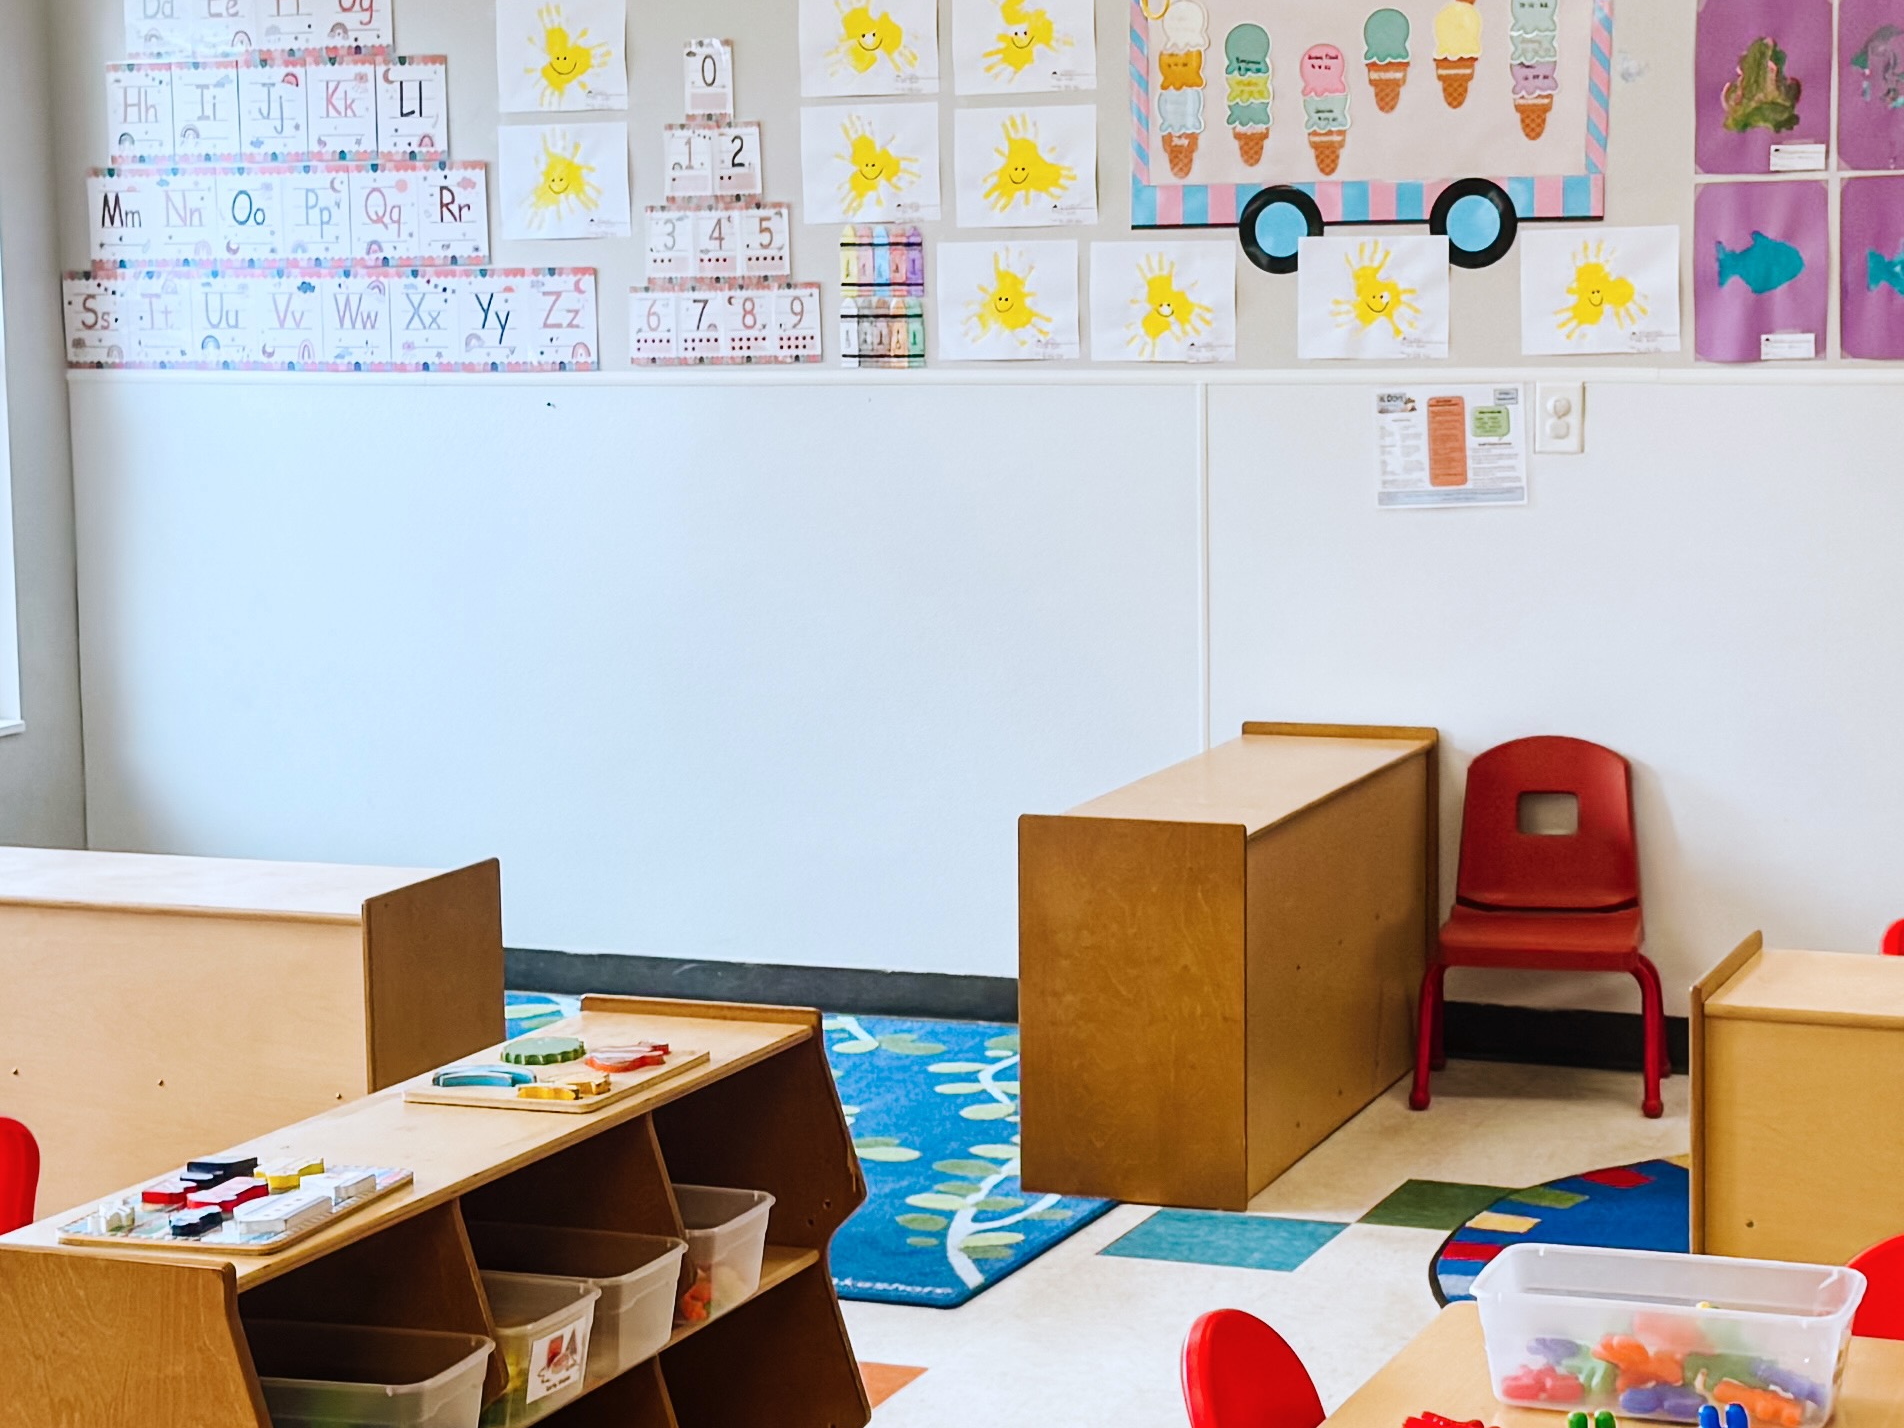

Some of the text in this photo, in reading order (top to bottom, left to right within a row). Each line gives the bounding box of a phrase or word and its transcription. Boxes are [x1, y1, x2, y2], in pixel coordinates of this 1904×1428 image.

[122, 85, 159, 124] Hh
[257, 82, 285, 135] Jj
[324, 81, 357, 119] Kk
[684, 135, 745, 170] 1 2
[101, 185, 471, 240] Mm Nn Oo Pp Qq Rr
[663, 216, 773, 251] 3 4 5
[81, 294, 110, 330] Ss
[205, 292, 239, 329] Uu
[272, 292, 305, 329] Vv
[333, 293, 378, 329] Ww
[405, 292, 441, 329] Xx
[474, 292, 510, 345] Yy
[542, 291, 581, 329] Zz
[646, 296, 804, 332] 6 7 8 9
